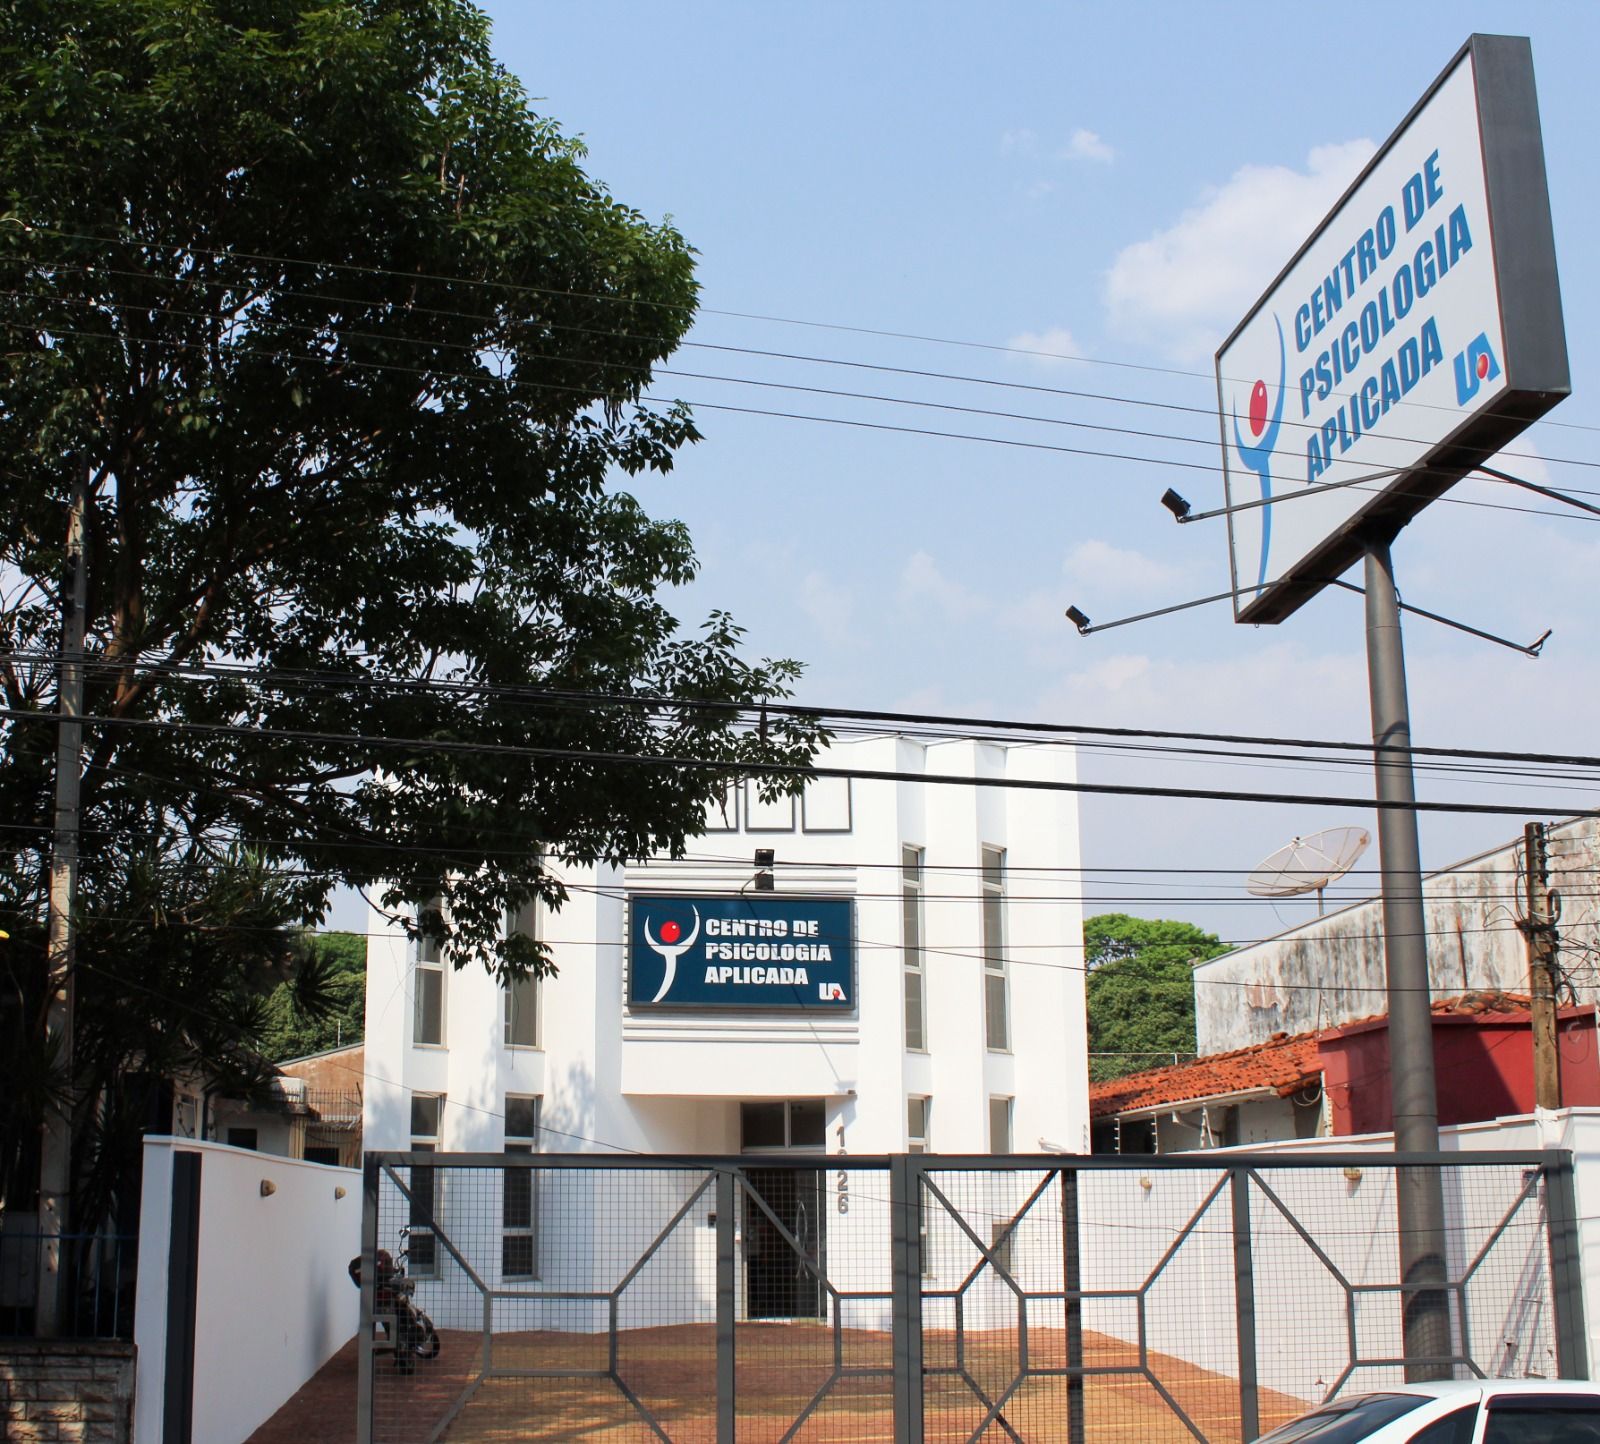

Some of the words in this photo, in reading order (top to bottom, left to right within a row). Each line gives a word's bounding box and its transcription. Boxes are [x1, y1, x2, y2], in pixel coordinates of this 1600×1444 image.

[1294, 205, 1396, 353] CENTRO
[1401, 148, 1444, 234] DE
[1300, 203, 1473, 419] PSICOLOGIA
[1306, 315, 1443, 485] APLICADA
[705, 918, 788, 937] CENTRO
[793, 920, 819, 937] DE
[705, 943, 832, 961] PSICOLOGIA
[704, 966, 809, 985] APLICADA
